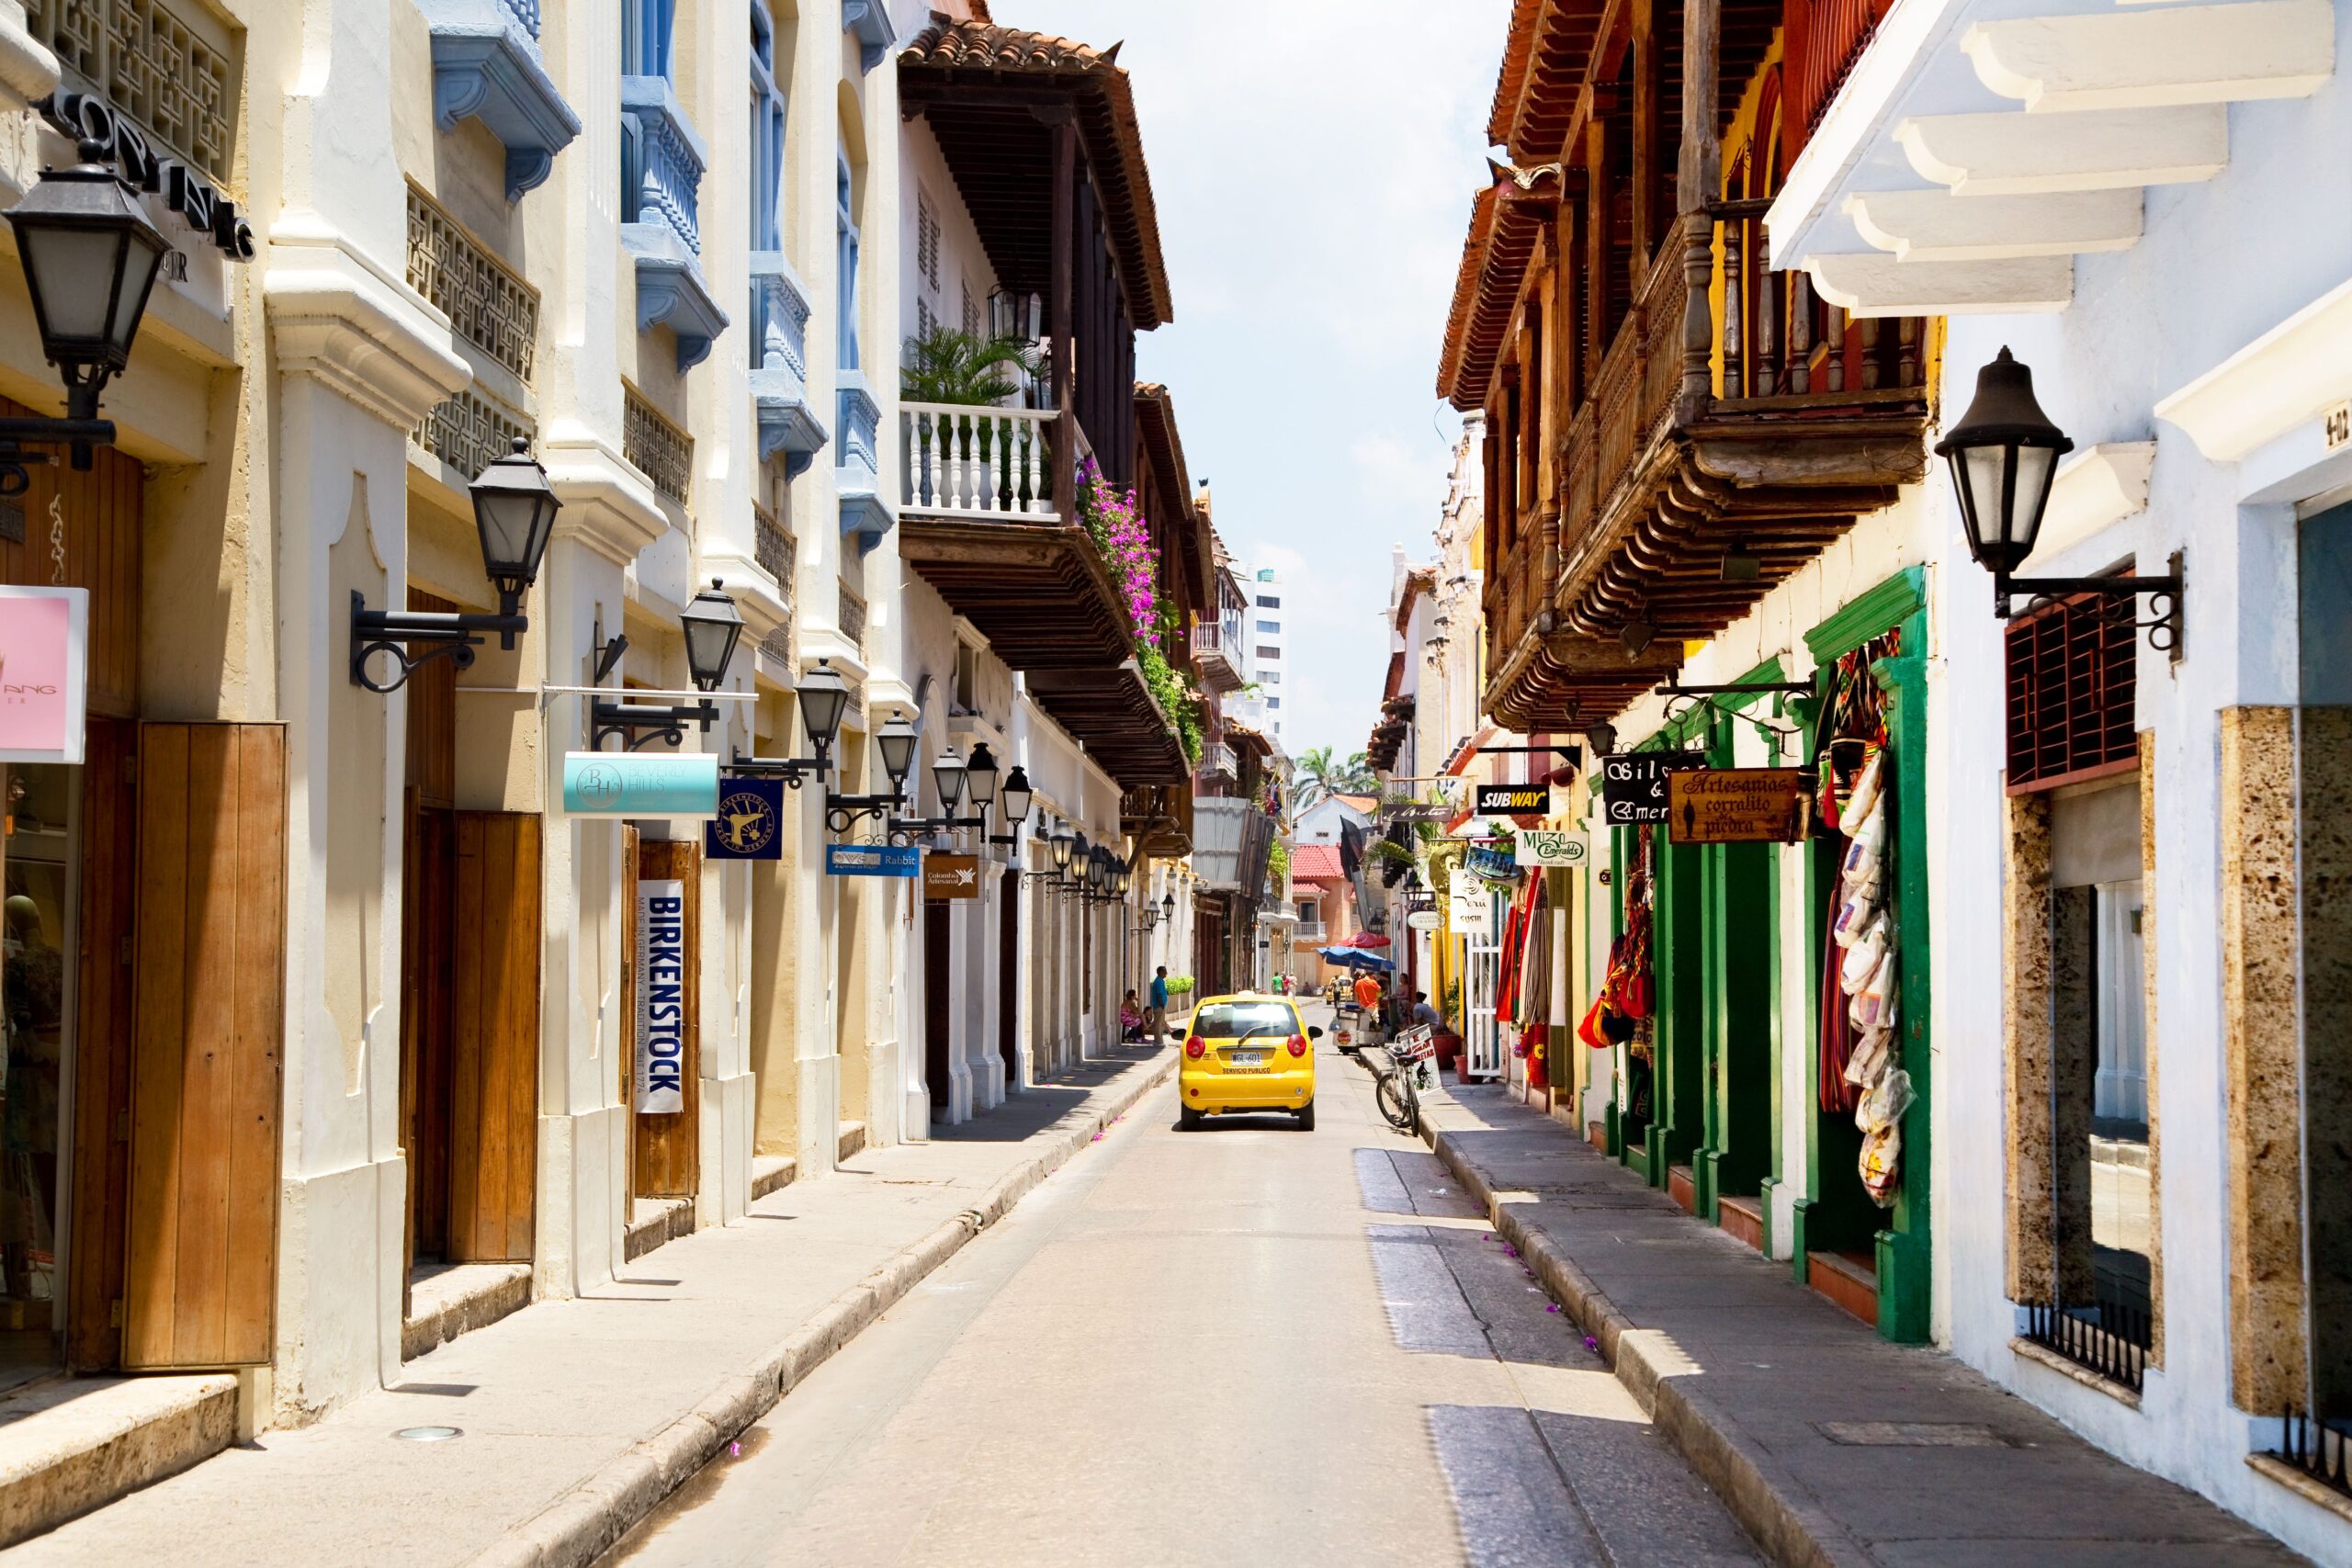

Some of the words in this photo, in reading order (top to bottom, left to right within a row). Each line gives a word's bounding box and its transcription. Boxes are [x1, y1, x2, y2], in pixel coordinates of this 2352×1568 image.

[628, 763, 688, 778] BEVERLY
[628, 778, 665, 792] HILLS
[1650, 781, 1664, 797] &
[1481, 791, 1547, 807] SUBWAY
[1705, 794, 1770, 812] corralito
[1611, 801, 1668, 820] Emer
[1544, 844, 1579, 855] Emeralds
[885, 855, 916, 865] Rabbit
[1460, 915, 1482, 923] SUSHI
[649, 897, 682, 1093] BIRKENSTOCK
[638, 995, 646, 1044] TRADITION
